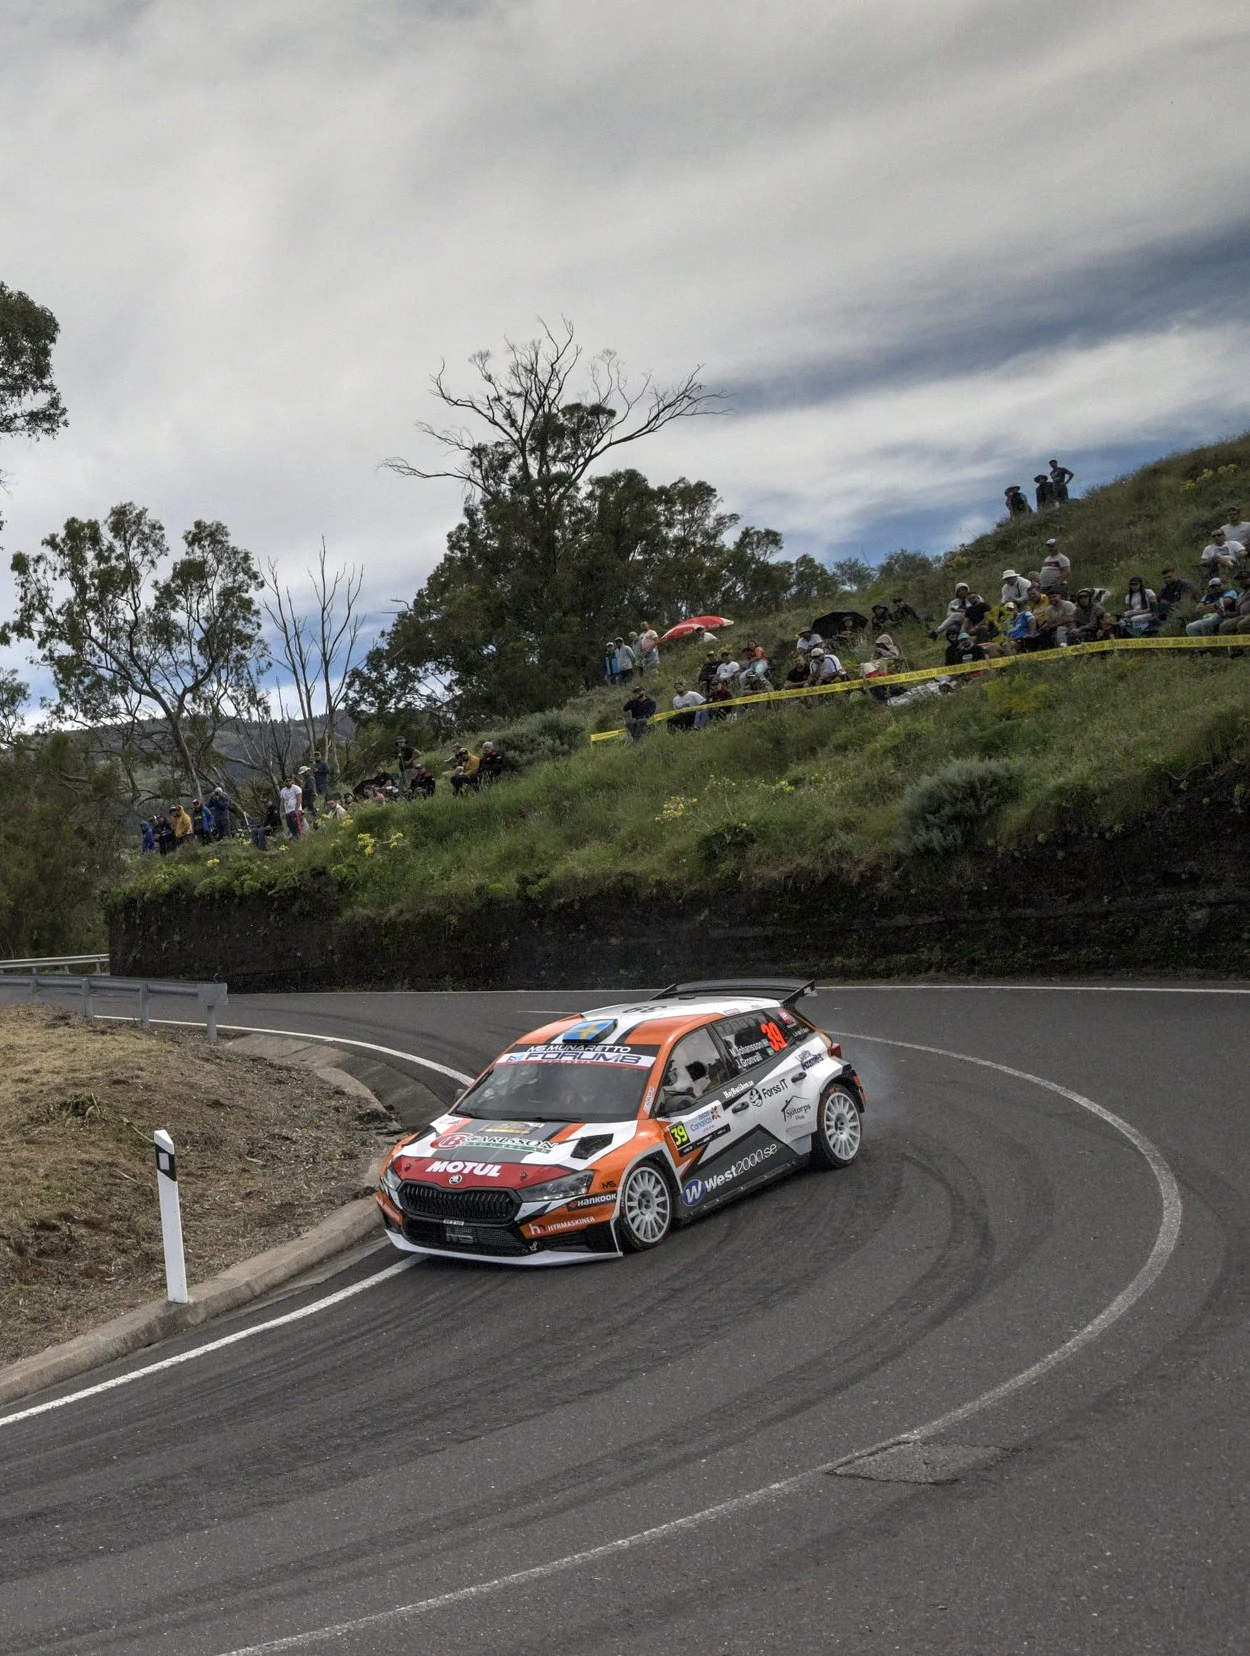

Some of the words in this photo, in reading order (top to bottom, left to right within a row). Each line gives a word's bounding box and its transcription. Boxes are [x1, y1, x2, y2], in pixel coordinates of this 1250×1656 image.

[760, 1021, 788, 1053] 39
[547, 1044, 631, 1053] MUNARETTO
[525, 1051, 642, 1065] FORUM8
[761, 1084, 782, 1099] Forss
[466, 1134, 559, 1150] CARLSSON
[670, 1124, 688, 1146] 39
[425, 1160, 502, 1177] MOTUL
[685, 1180, 702, 1203] W
[704, 1143, 778, 1193] West2000.se
[548, 1216, 596, 1232] HYRMASKINER
